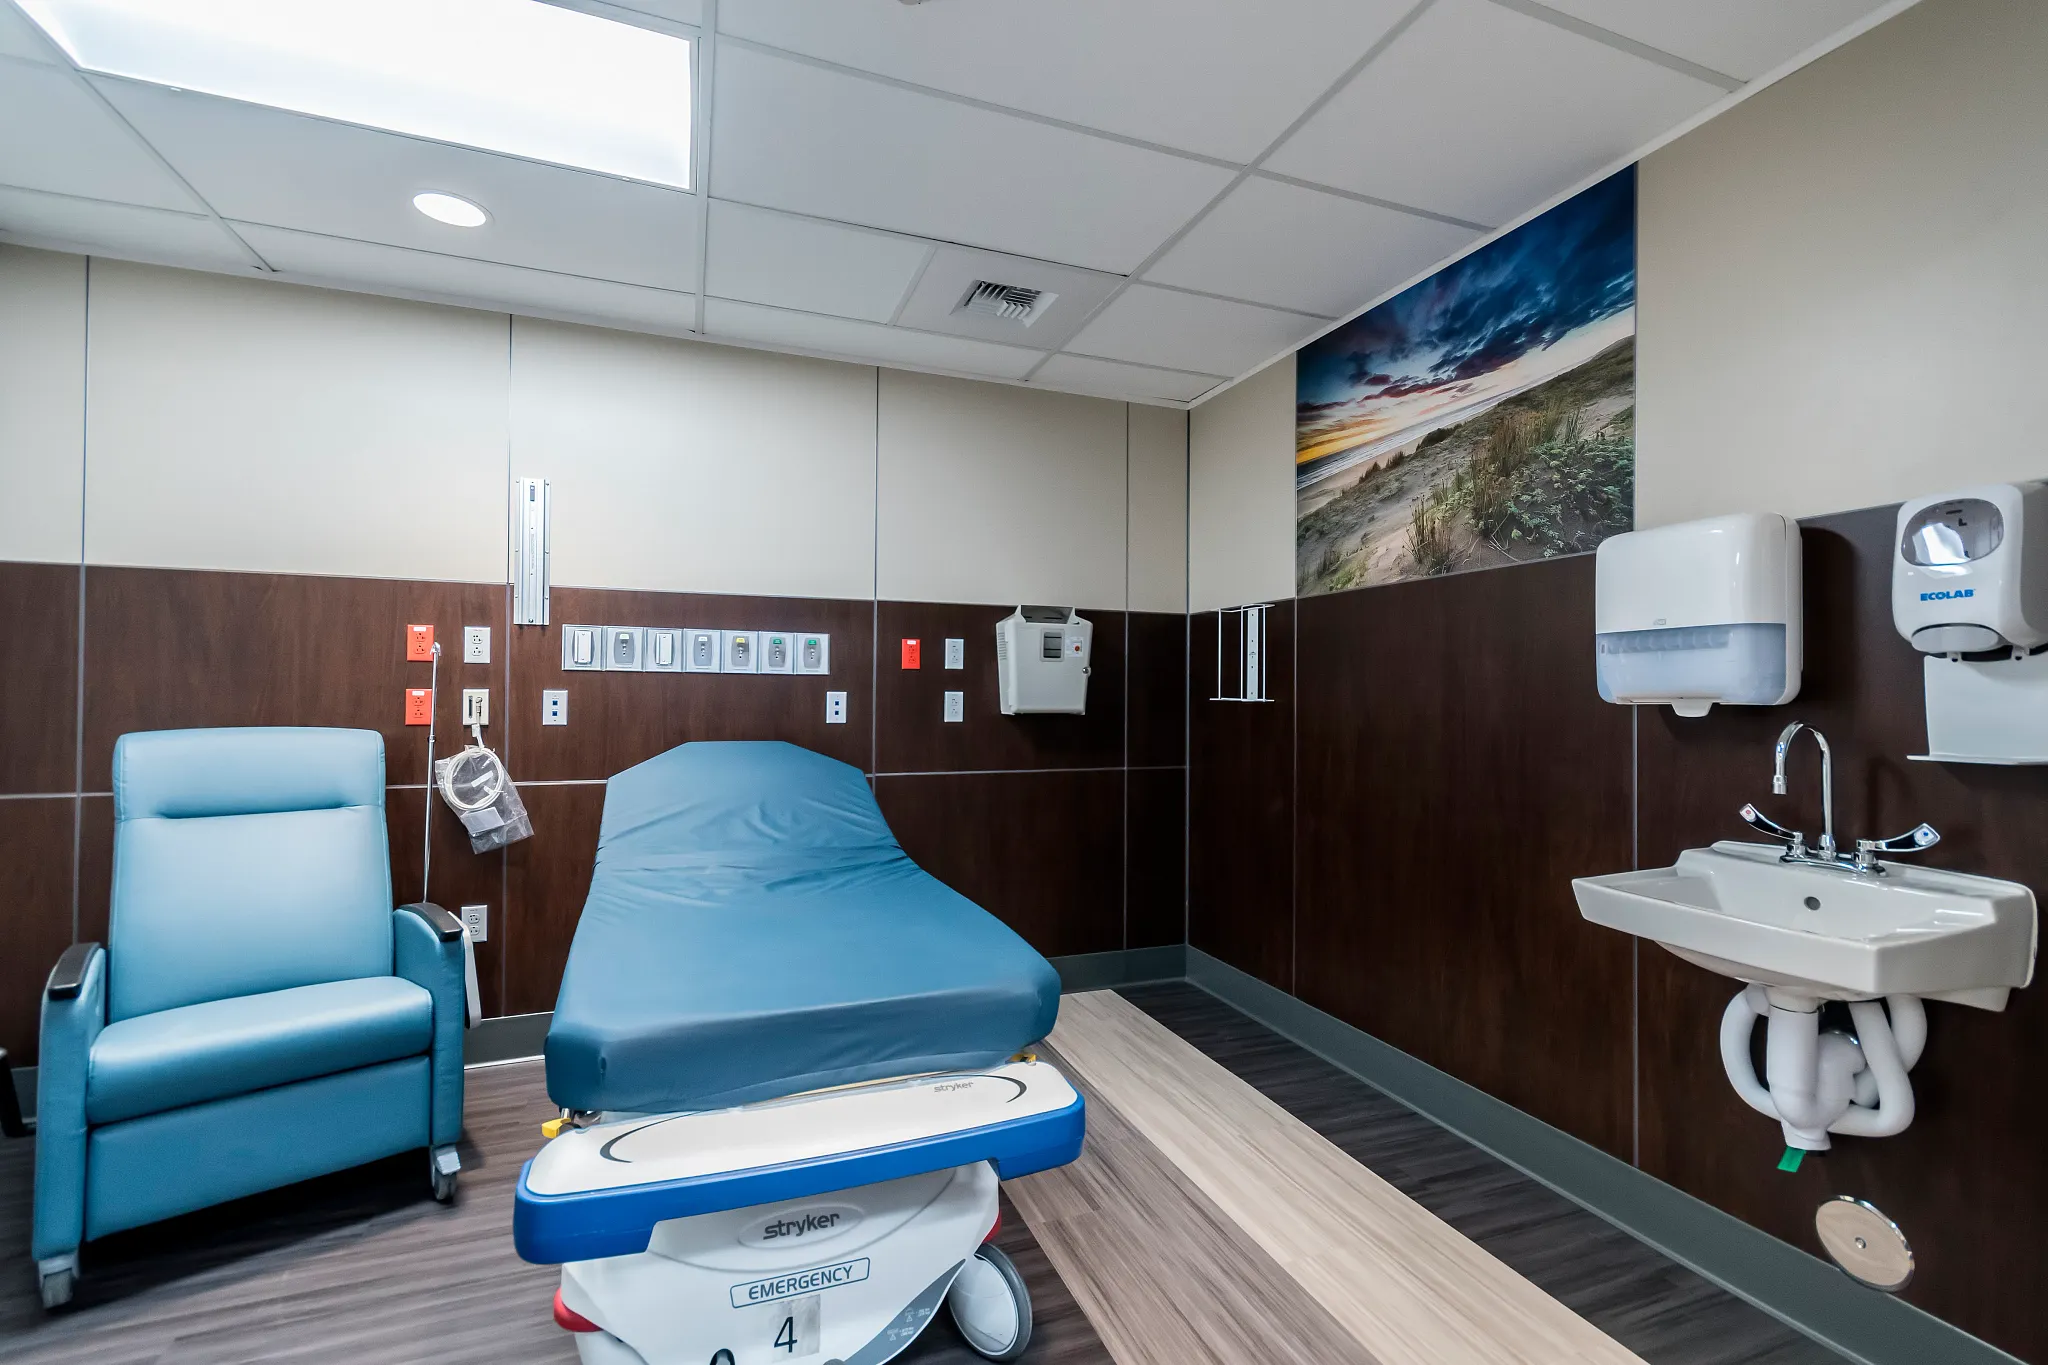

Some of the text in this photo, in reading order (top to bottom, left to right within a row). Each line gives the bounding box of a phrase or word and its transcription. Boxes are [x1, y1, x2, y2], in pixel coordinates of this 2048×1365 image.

[1920, 589, 1974, 601] ECOLAB
[934, 1081, 974, 1093] stryker
[763, 1213, 840, 1240] stryker
[749, 1265, 853, 1300] EMERGENCY
[773, 1316, 798, 1353] 4
